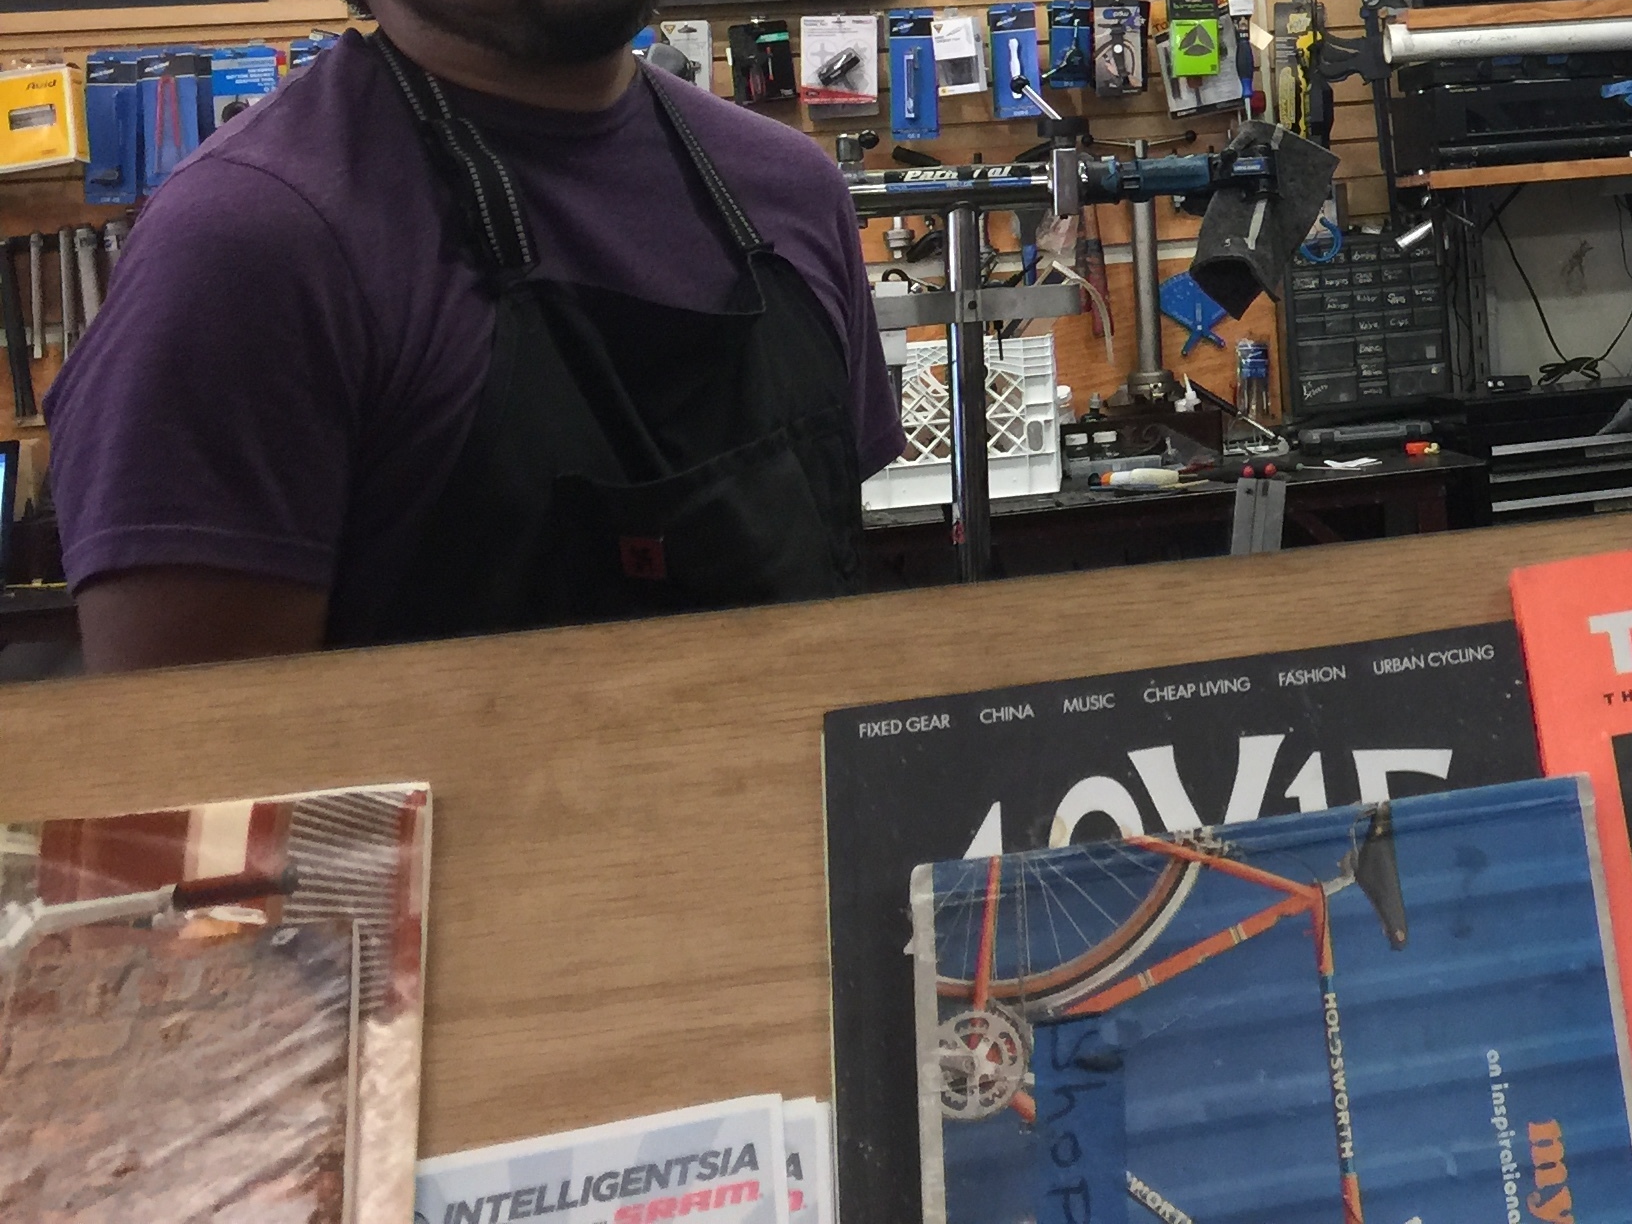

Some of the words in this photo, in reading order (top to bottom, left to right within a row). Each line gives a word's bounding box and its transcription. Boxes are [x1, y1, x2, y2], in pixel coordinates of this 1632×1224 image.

[1373, 654, 1425, 676] URBAN
[1427, 644, 1495, 668] CYCLING
[1277, 665, 1347, 687] FASHION
[1062, 692, 1116, 714] MUSIC
[1143, 683, 1197, 704] CHEAP
[1199, 676, 1251, 697] LIVING
[858, 719, 902, 739] FIXED
[905, 713, 951, 734] GEAR
[979, 704, 1035, 724] CHINA
[1322, 991, 1358, 1160] HOLDSWORTH
[443, 1142, 760, 1224] INTELLIGENTSIA
